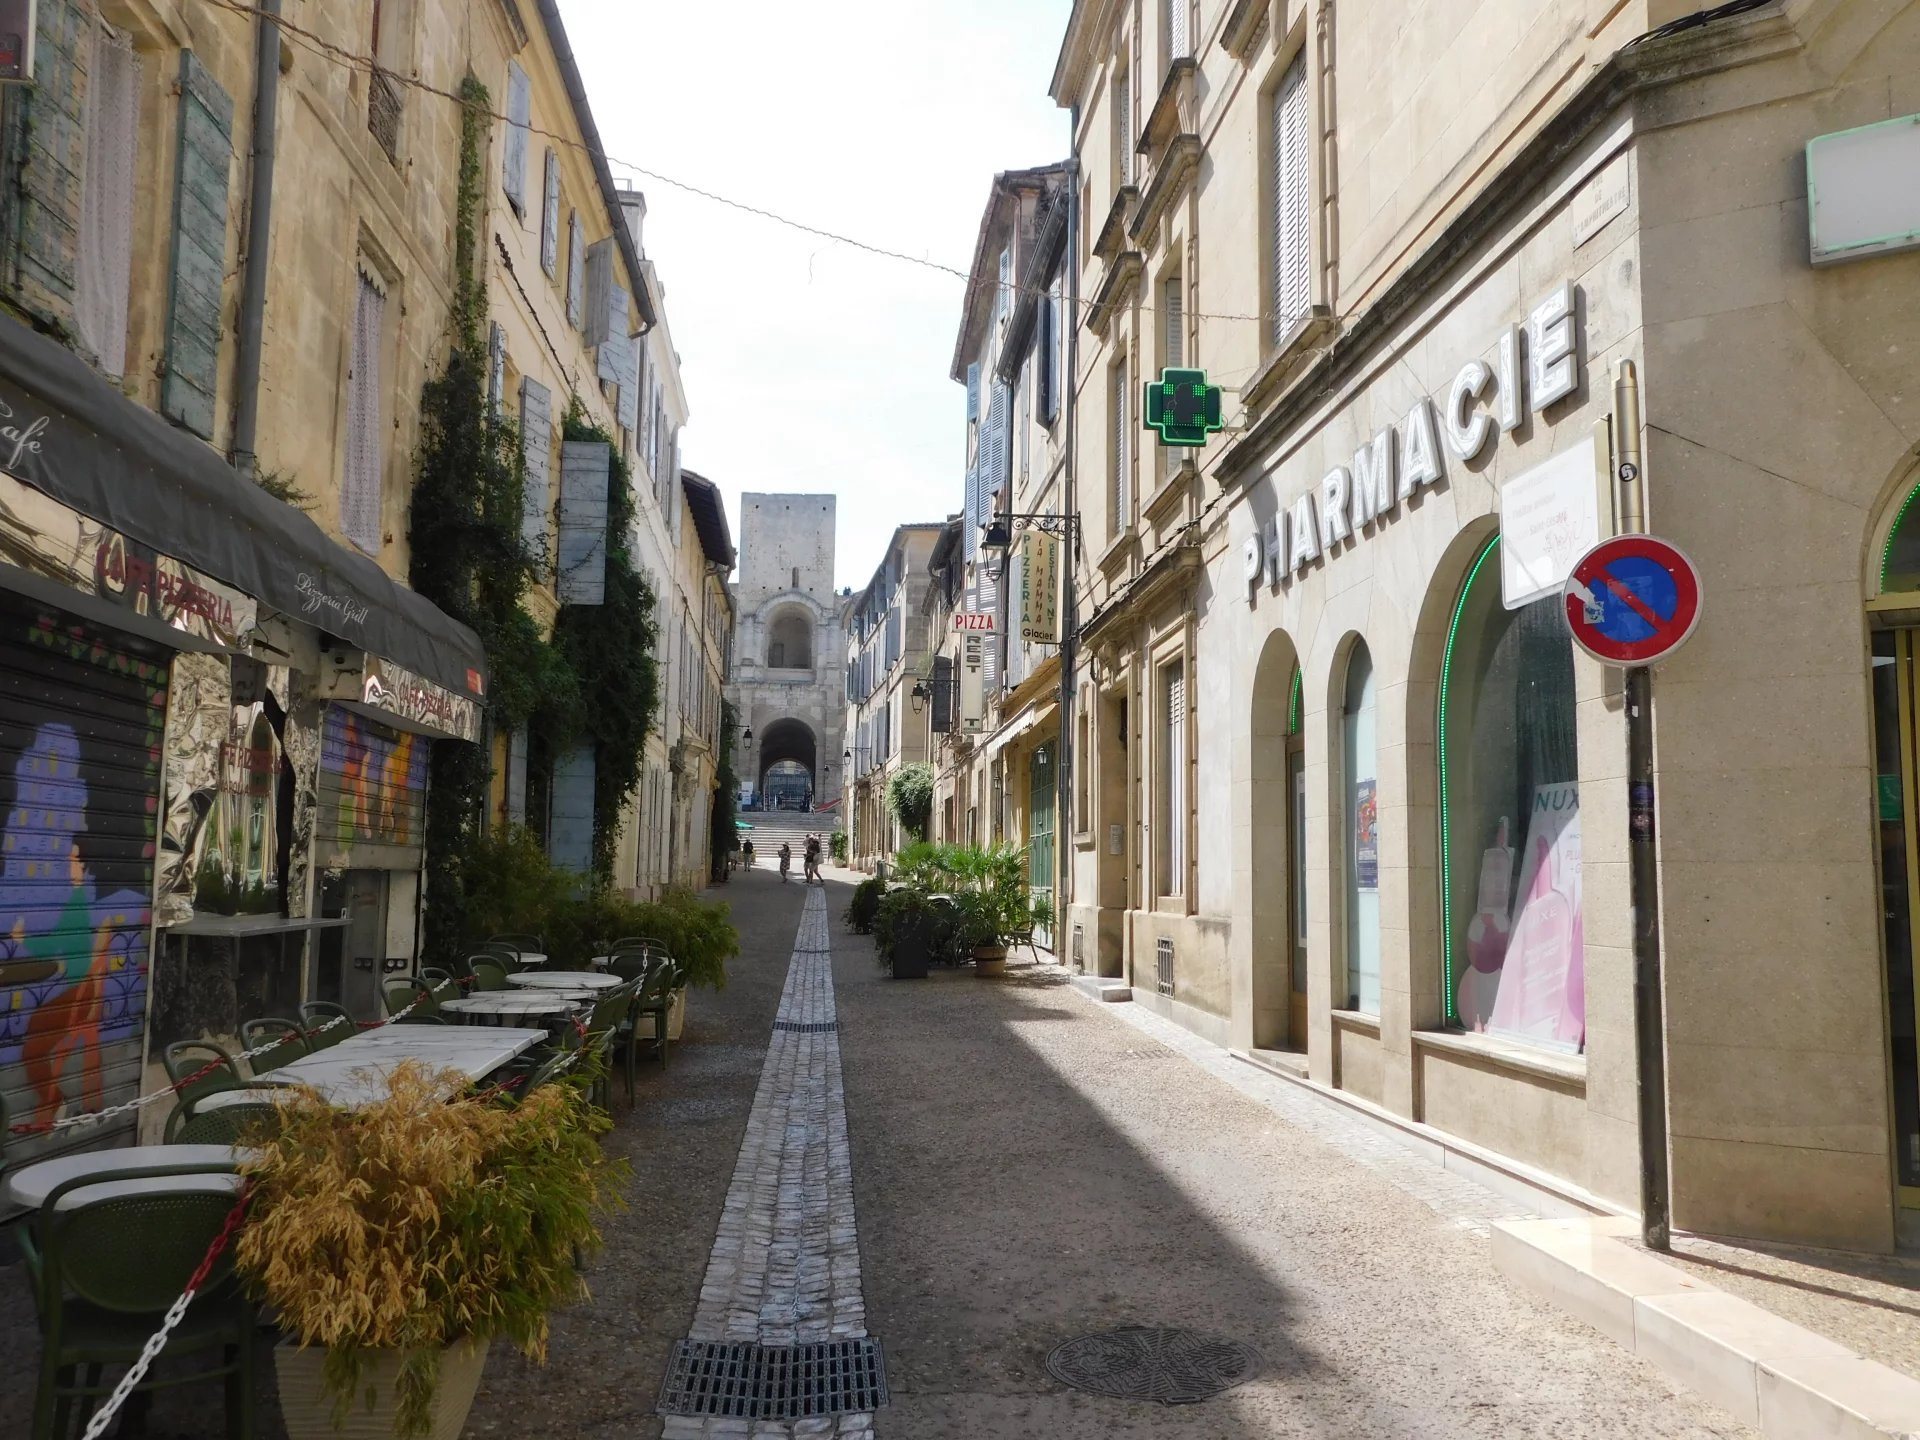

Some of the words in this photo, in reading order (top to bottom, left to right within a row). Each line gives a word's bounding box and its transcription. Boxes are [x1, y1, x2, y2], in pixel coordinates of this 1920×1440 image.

[1243, 279, 1578, 603] PHARMACIE
[294, 572, 342, 614] Pizzeria
[343, 595, 369, 625] Grill
[1022, 534, 1031, 623] PIZZERIA
[1035, 565, 1043, 625] MAMMA
[955, 614, 994, 630] PIZZA
[1022, 627, 1054, 641] Glacier
